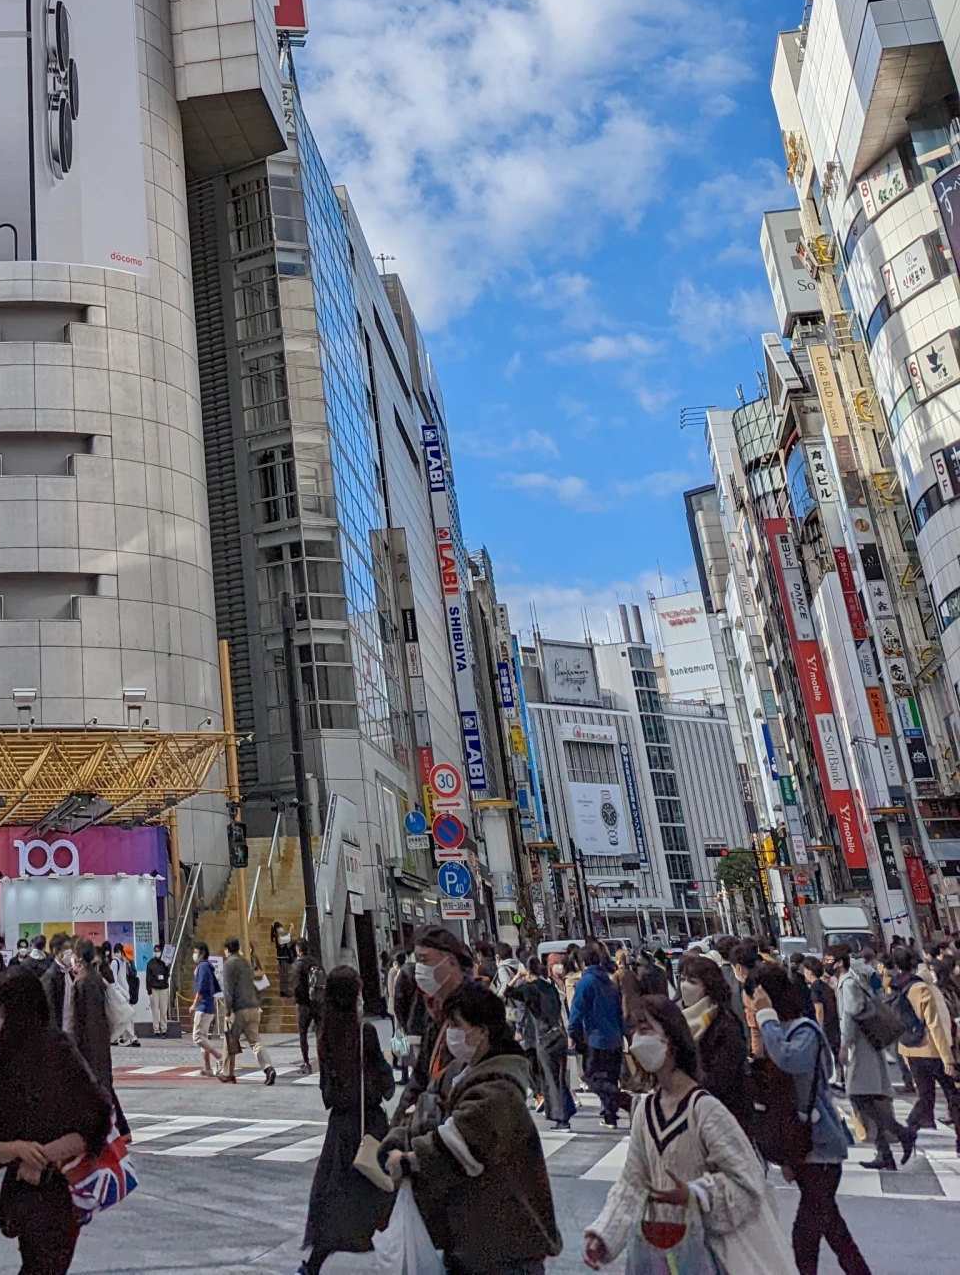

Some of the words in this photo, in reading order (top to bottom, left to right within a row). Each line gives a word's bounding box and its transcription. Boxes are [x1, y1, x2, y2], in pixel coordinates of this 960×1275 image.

[110, 252, 143, 266] docomo
[827, 410, 840, 429] COAST
[425, 445, 445, 489] LABI
[438, 543, 459, 596] LABI
[742, 590, 752, 606] DOT
[793, 583, 808, 620] DANCE
[448, 606, 467, 672] SHIBUYA
[669, 663, 715, 676] Bunkamura
[806, 653, 822, 701] Y!mobile
[464, 734, 486, 785] LABI
[824, 735, 842, 785] SoftBank
[437, 773, 455, 789] 30
[839, 802, 855, 854] Y!mobile
[14, 839, 80, 876] 109
[444, 871, 458, 894] P
[455, 883, 465, 894] 40
[72, 904, 107, 916] ツバメ
